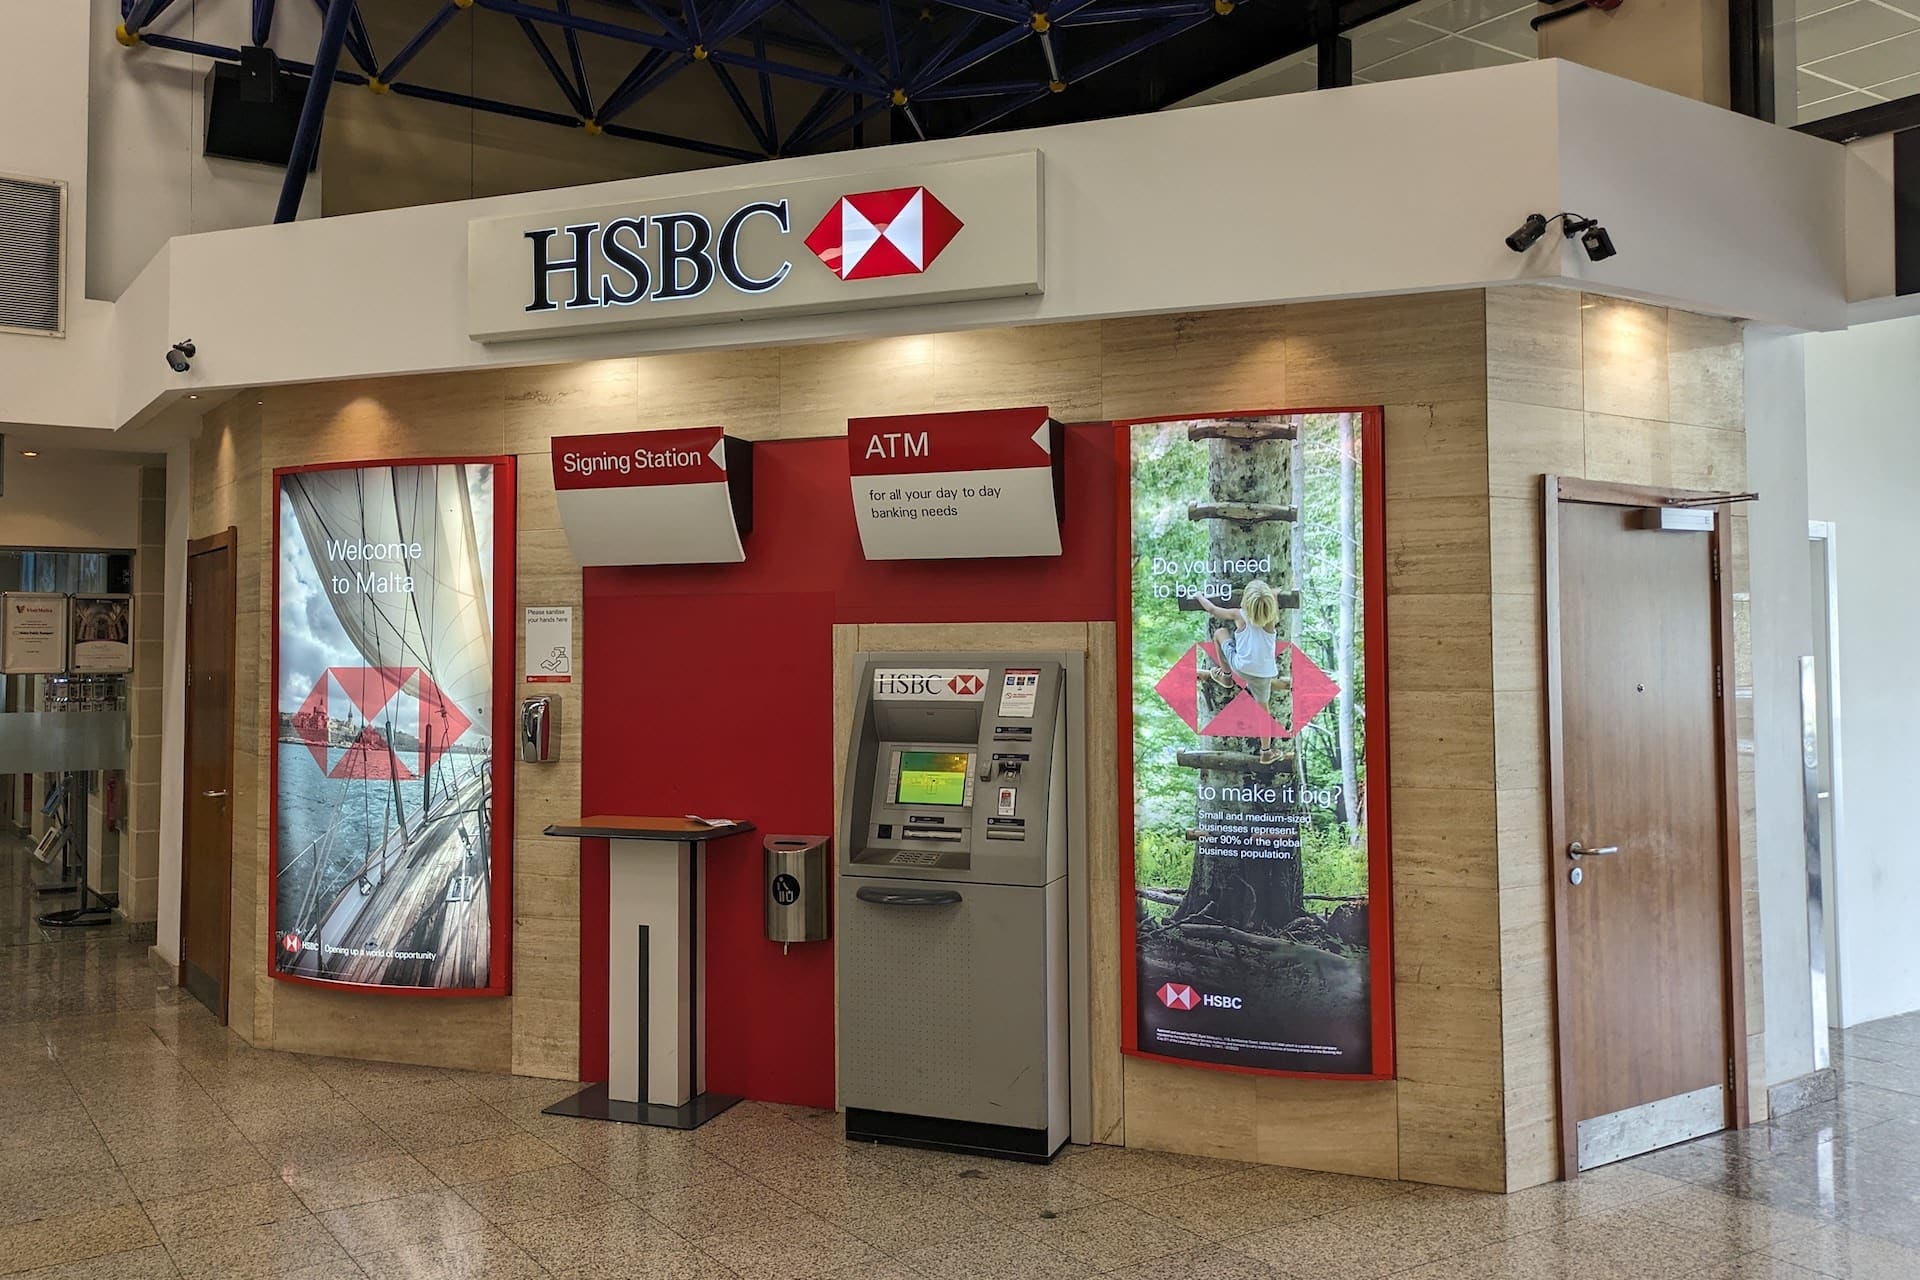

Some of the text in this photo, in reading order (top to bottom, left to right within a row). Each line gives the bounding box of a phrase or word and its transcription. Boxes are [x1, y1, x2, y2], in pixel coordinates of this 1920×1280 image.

[524, 199, 793, 312] HSBC
[865, 431, 929, 460] ATM
[563, 447, 702, 476] Signing Station
[869, 485, 1001, 502] for all your day to day
[872, 505, 958, 520] banking needs
[326, 538, 422, 562] Welcome
[1153, 554, 1271, 577] Do you need
[332, 571, 415, 595] to Malta
[1152, 579, 1233, 601] to be big
[878, 673, 942, 695] HSBC
[1198, 783, 1343, 808] to make it big?
[1198, 810, 1312, 824] Small and medium-sized
[1198, 823, 1295, 836] businesses represent
[1198, 835, 1303, 850] over 90% of the global
[1198, 847, 1294, 860] business population.
[301, 941, 320, 952] HSBC
[324, 943, 350, 956] Opening
[350, 948, 359, 958] up
[365, 948, 385, 958] world
[386, 949, 394, 958] of
[394, 950, 437, 961] opportunity
[1203, 993, 1243, 1010] HSBC
